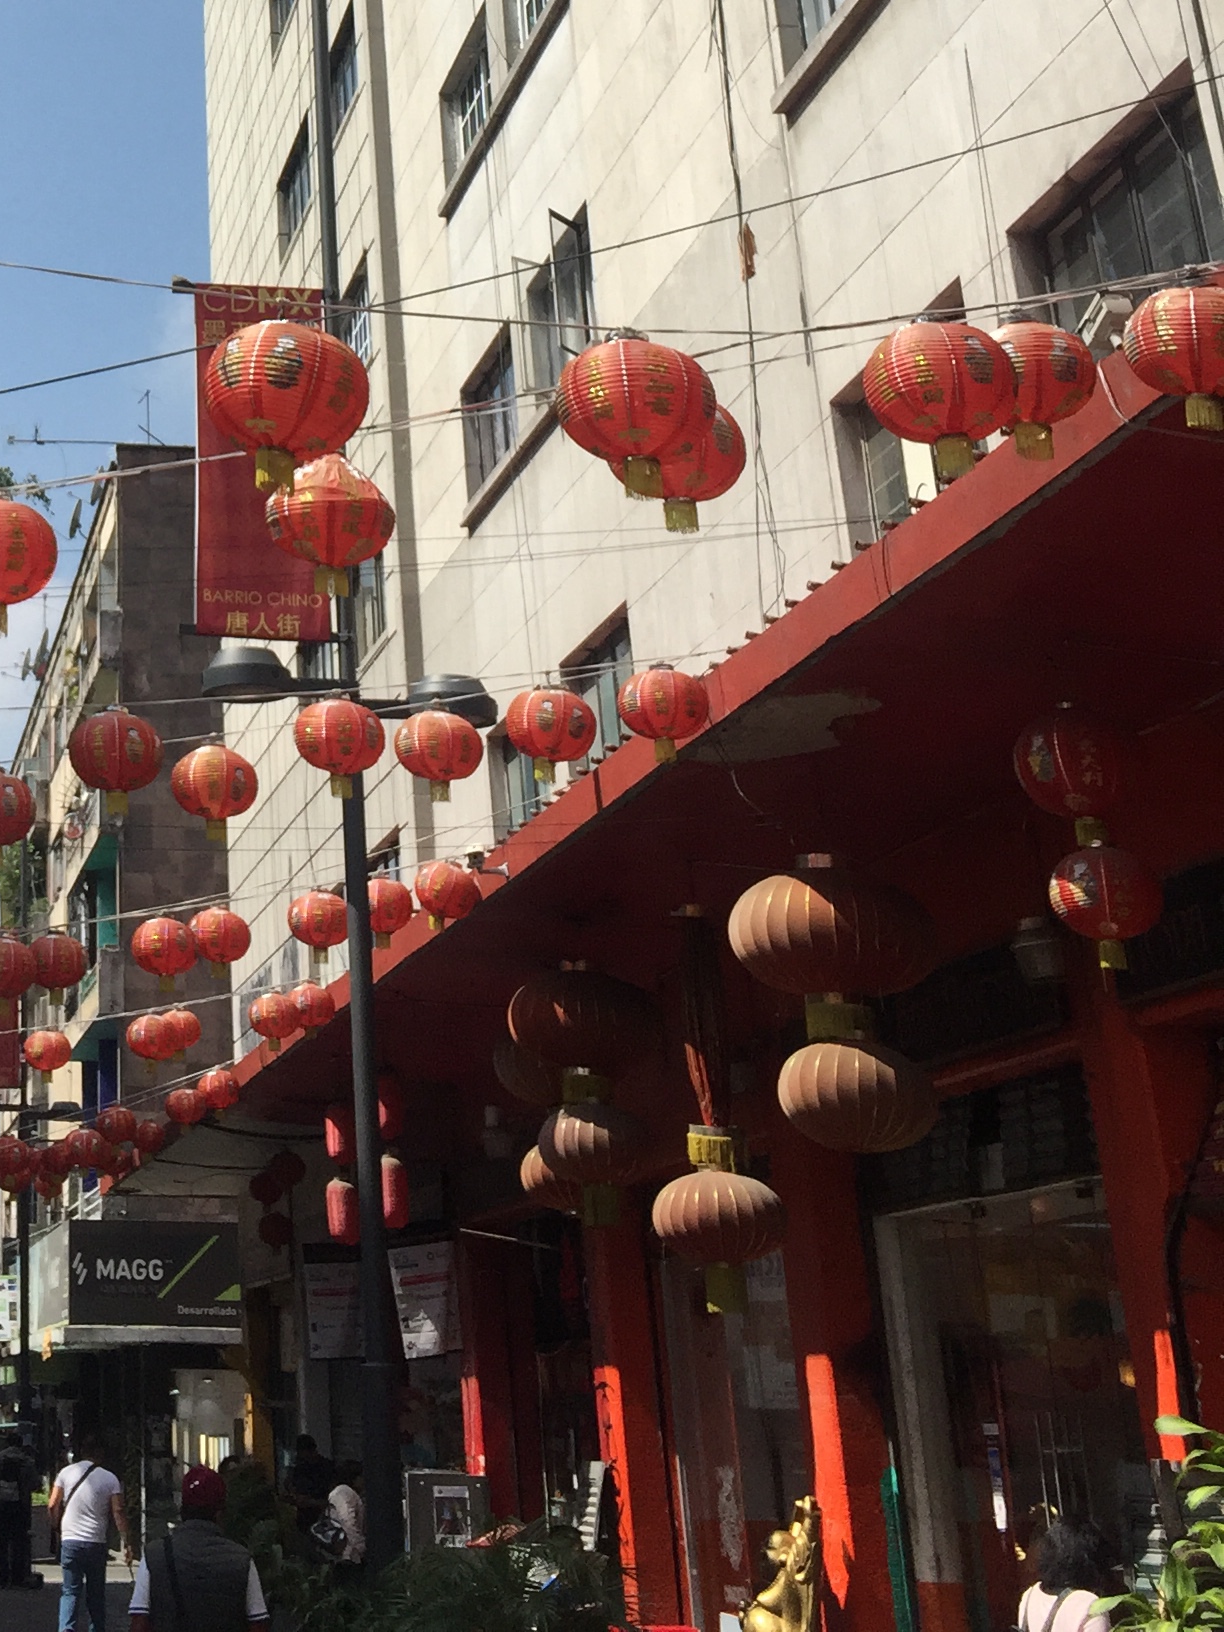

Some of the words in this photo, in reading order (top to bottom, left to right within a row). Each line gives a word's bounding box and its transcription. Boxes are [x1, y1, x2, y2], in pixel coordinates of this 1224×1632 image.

[202, 285, 313, 316] CDMX
[202, 588, 263, 605] BARRIO
[267, 592, 323, 608] CHINO
[225, 610, 301, 637] 唐人街
[95, 1258, 164, 1281] MAGG
